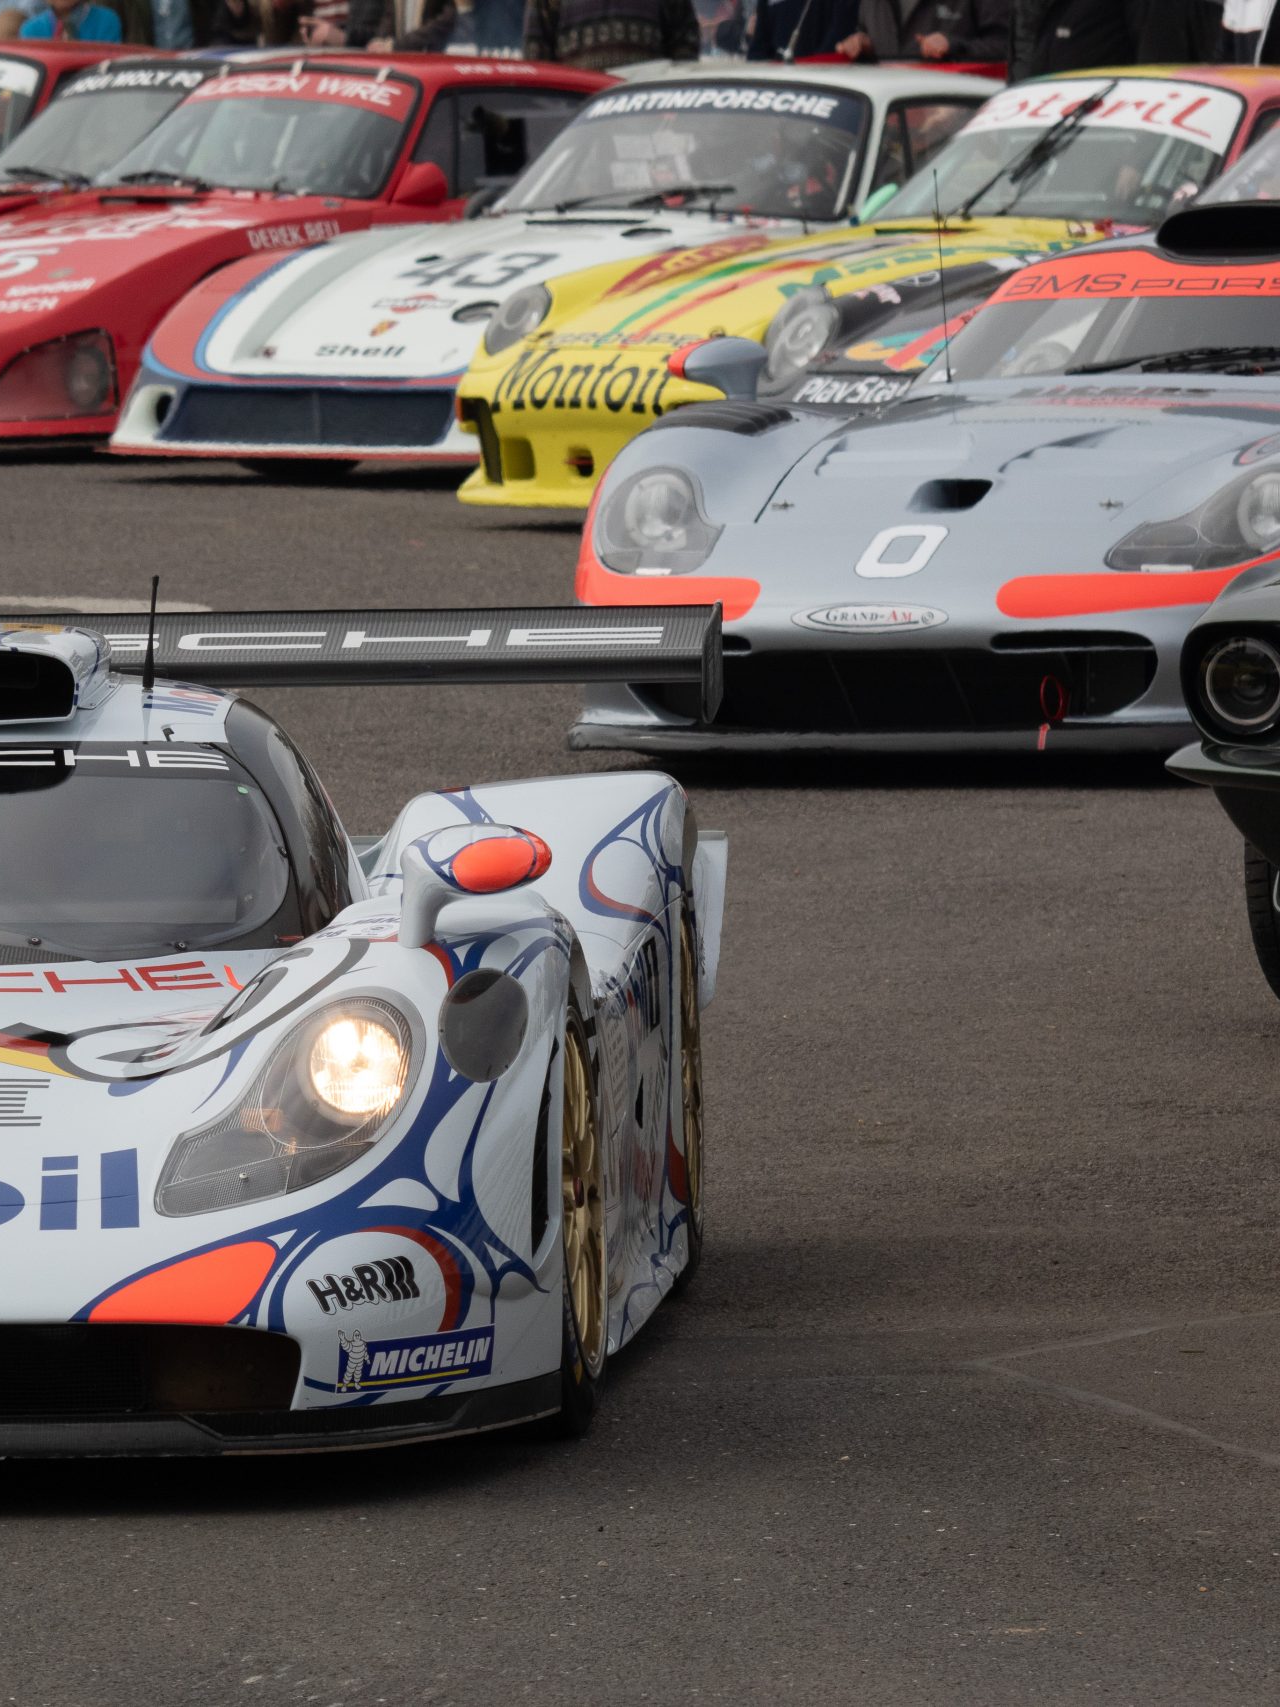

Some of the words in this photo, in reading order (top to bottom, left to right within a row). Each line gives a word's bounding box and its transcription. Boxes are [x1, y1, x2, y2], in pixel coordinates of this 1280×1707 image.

[316, 76, 402, 106] WIRE
[247, 222, 304, 250] DEREK
[396, 252, 560, 288] 43
[1003, 274, 1126, 297] BMS
[1130, 277, 1280, 291] POR
[315, 345, 406, 357] Shell
[856, 525, 949, 578] 0
[306, 1260, 401, 1315] H&R
[369, 1336, 491, 1367] MICHELIN
